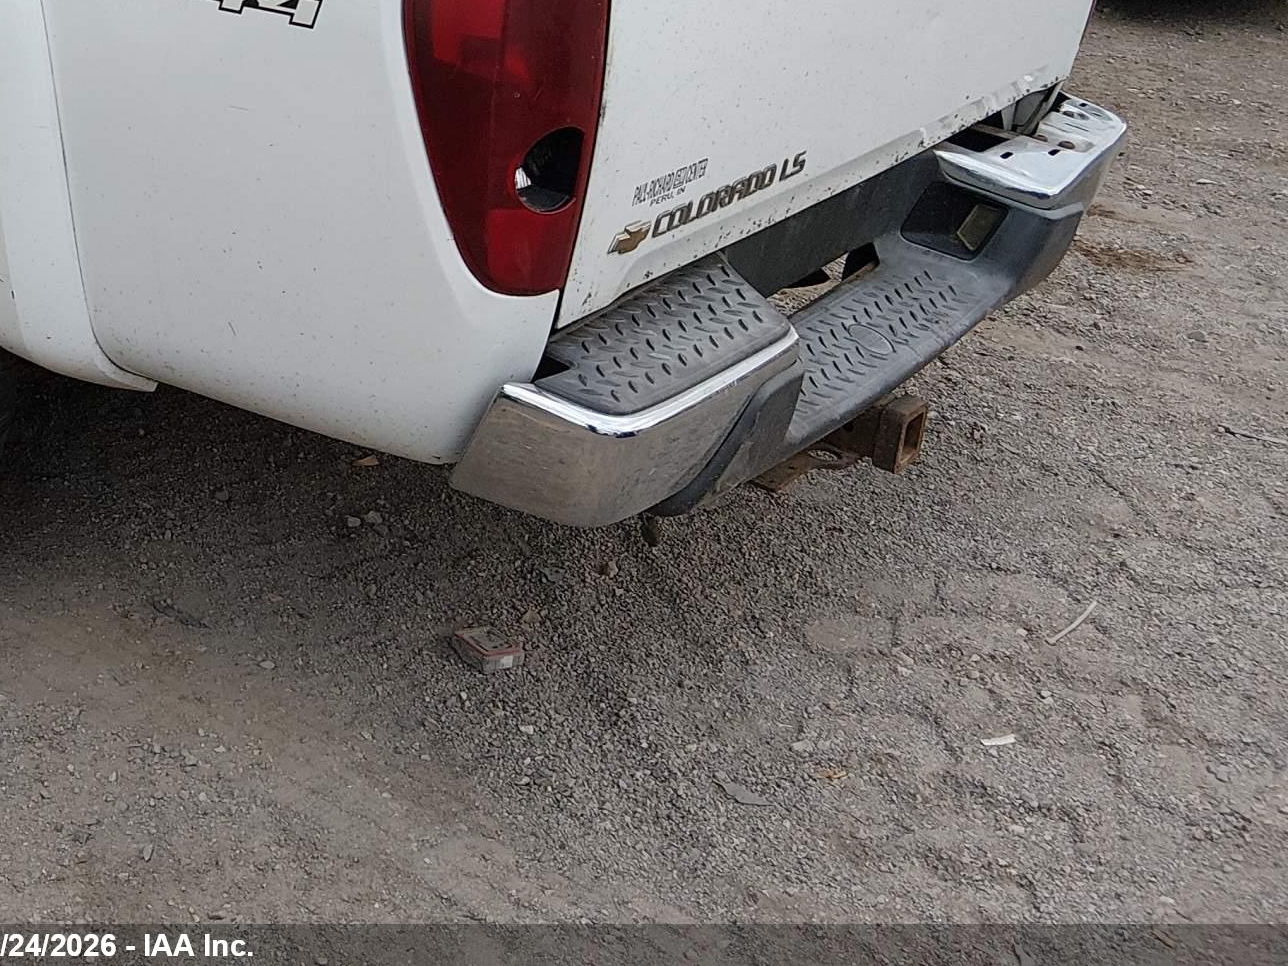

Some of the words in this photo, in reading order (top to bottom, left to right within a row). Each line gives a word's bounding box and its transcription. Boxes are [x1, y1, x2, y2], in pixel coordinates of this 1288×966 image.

[651, 163, 777, 238] COLORADO
[779, 150, 807, 182] LS
[676, 186, 687, 195] IN
